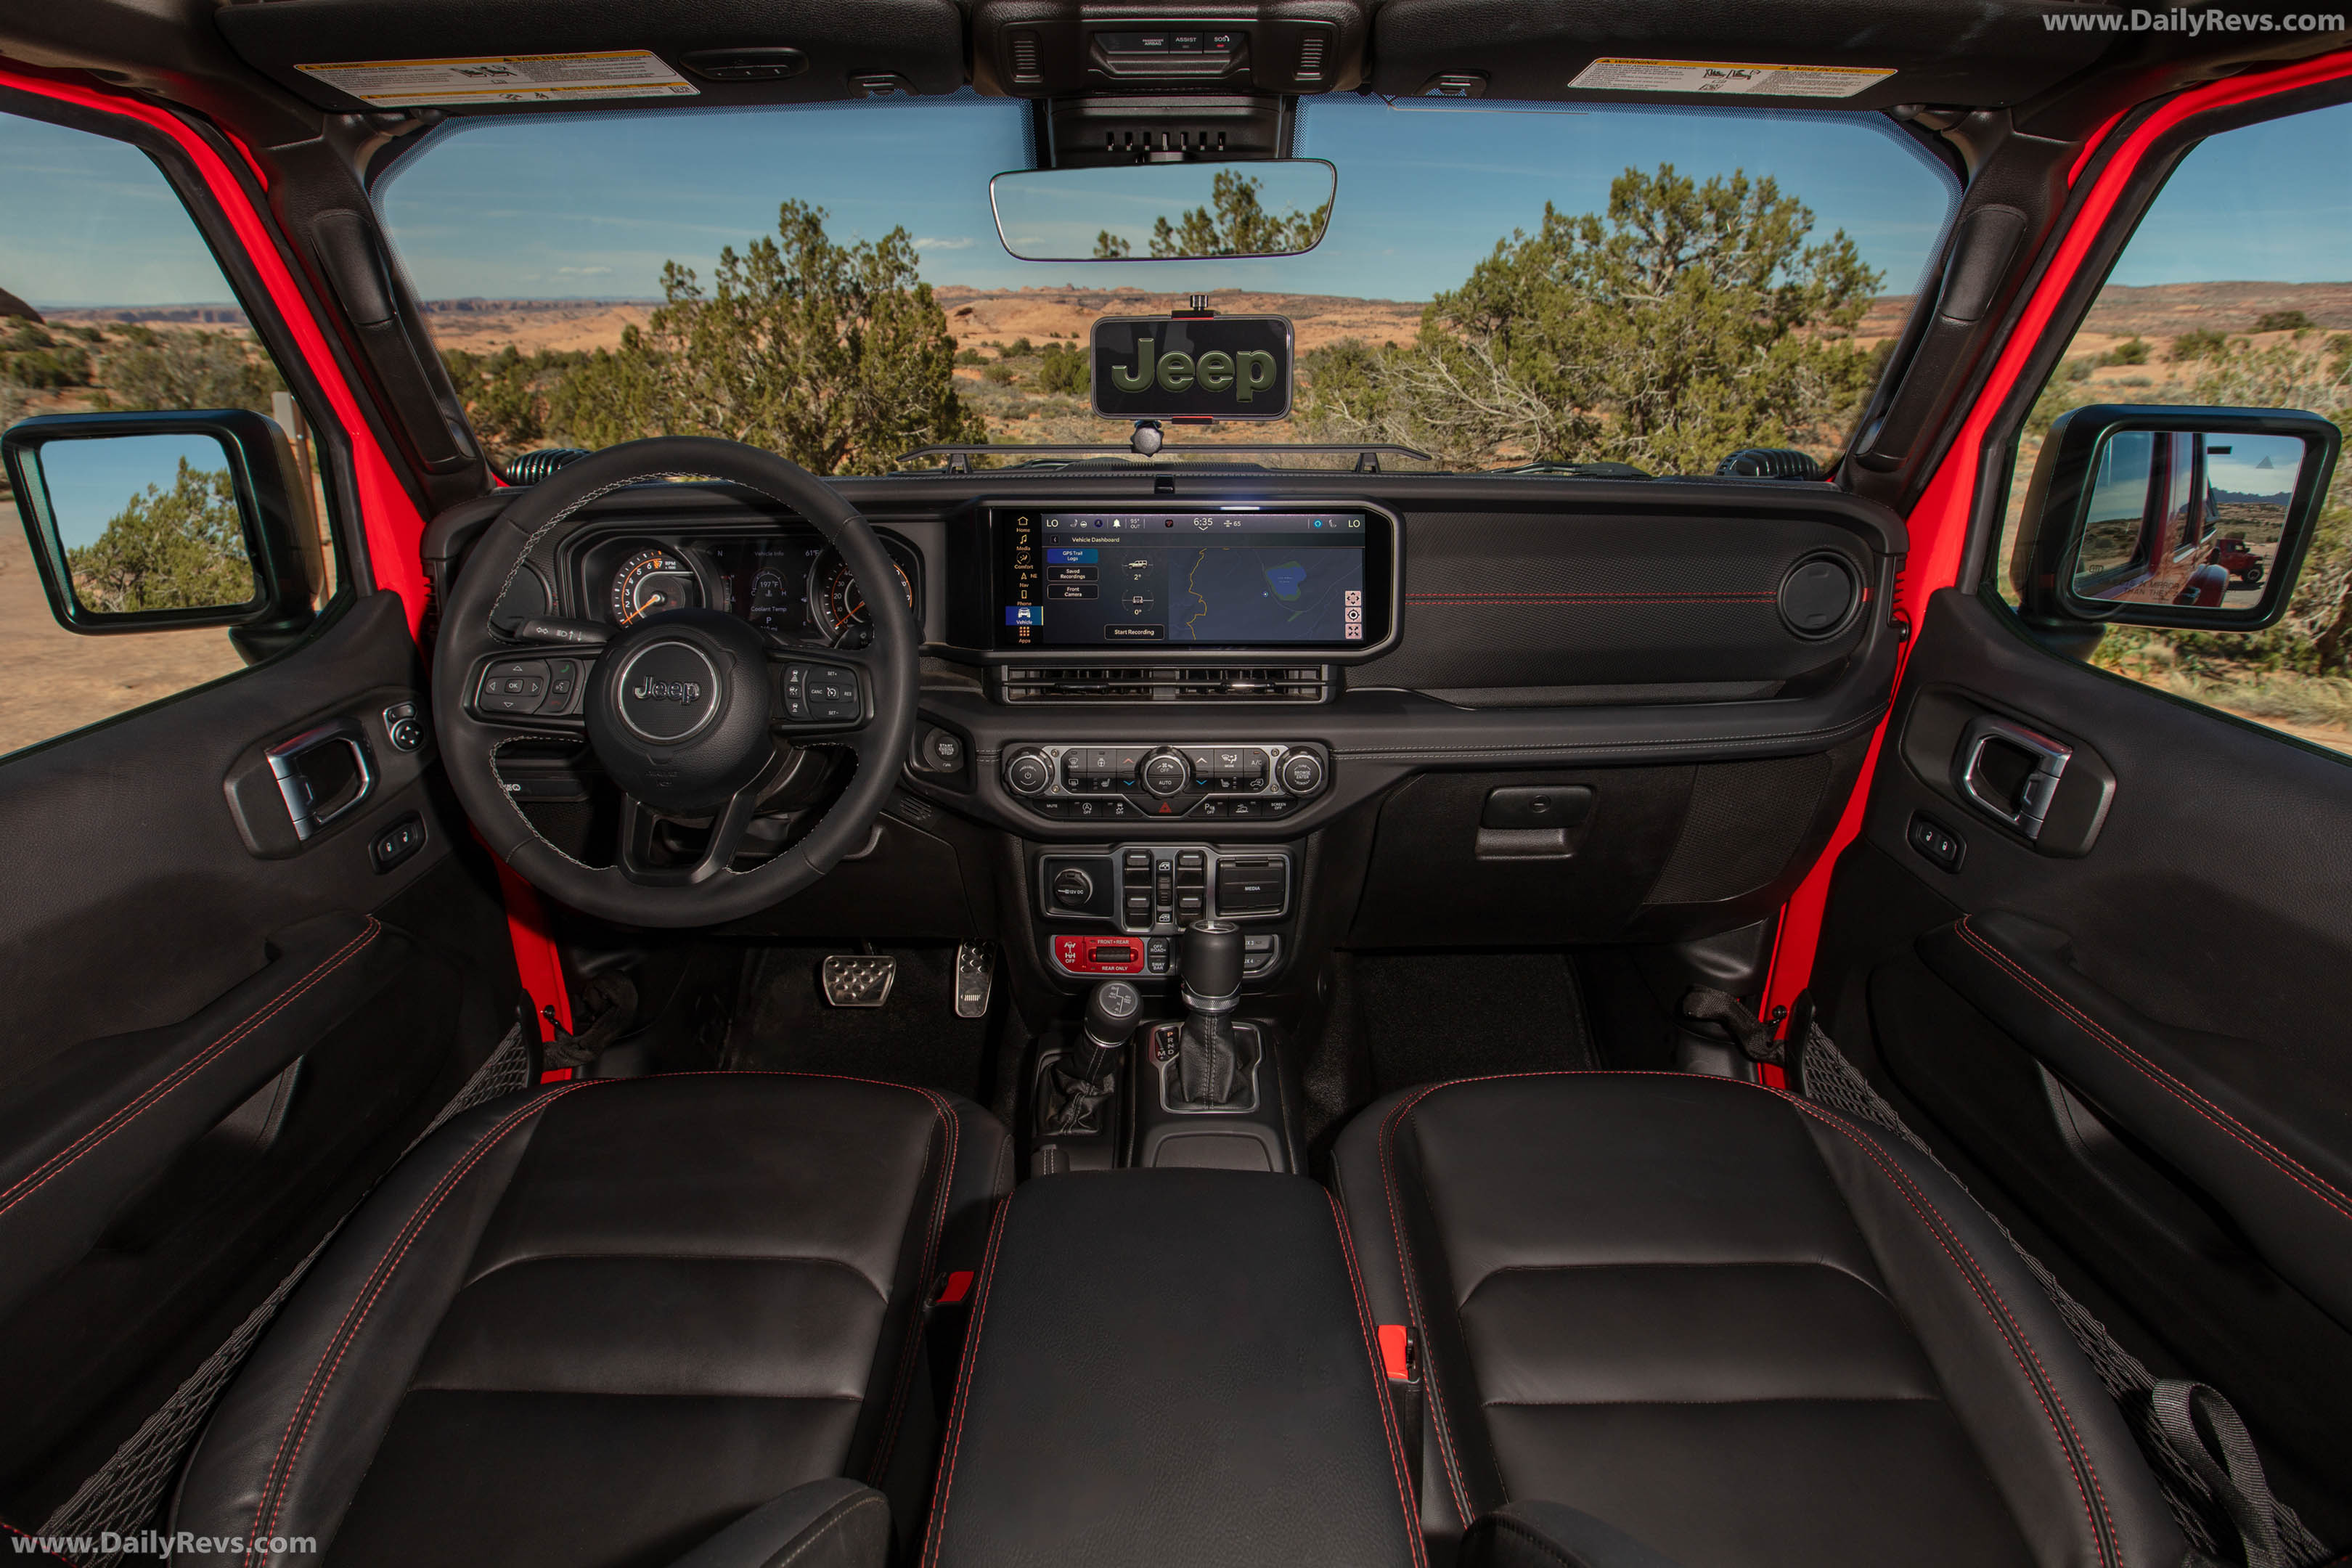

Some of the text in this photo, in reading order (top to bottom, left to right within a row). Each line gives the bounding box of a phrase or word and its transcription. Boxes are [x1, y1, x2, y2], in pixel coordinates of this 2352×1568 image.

[1111, 338, 1278, 402] Jeep
[1348, 519, 1360, 528] LO
[634, 675, 701, 706] Jeep
